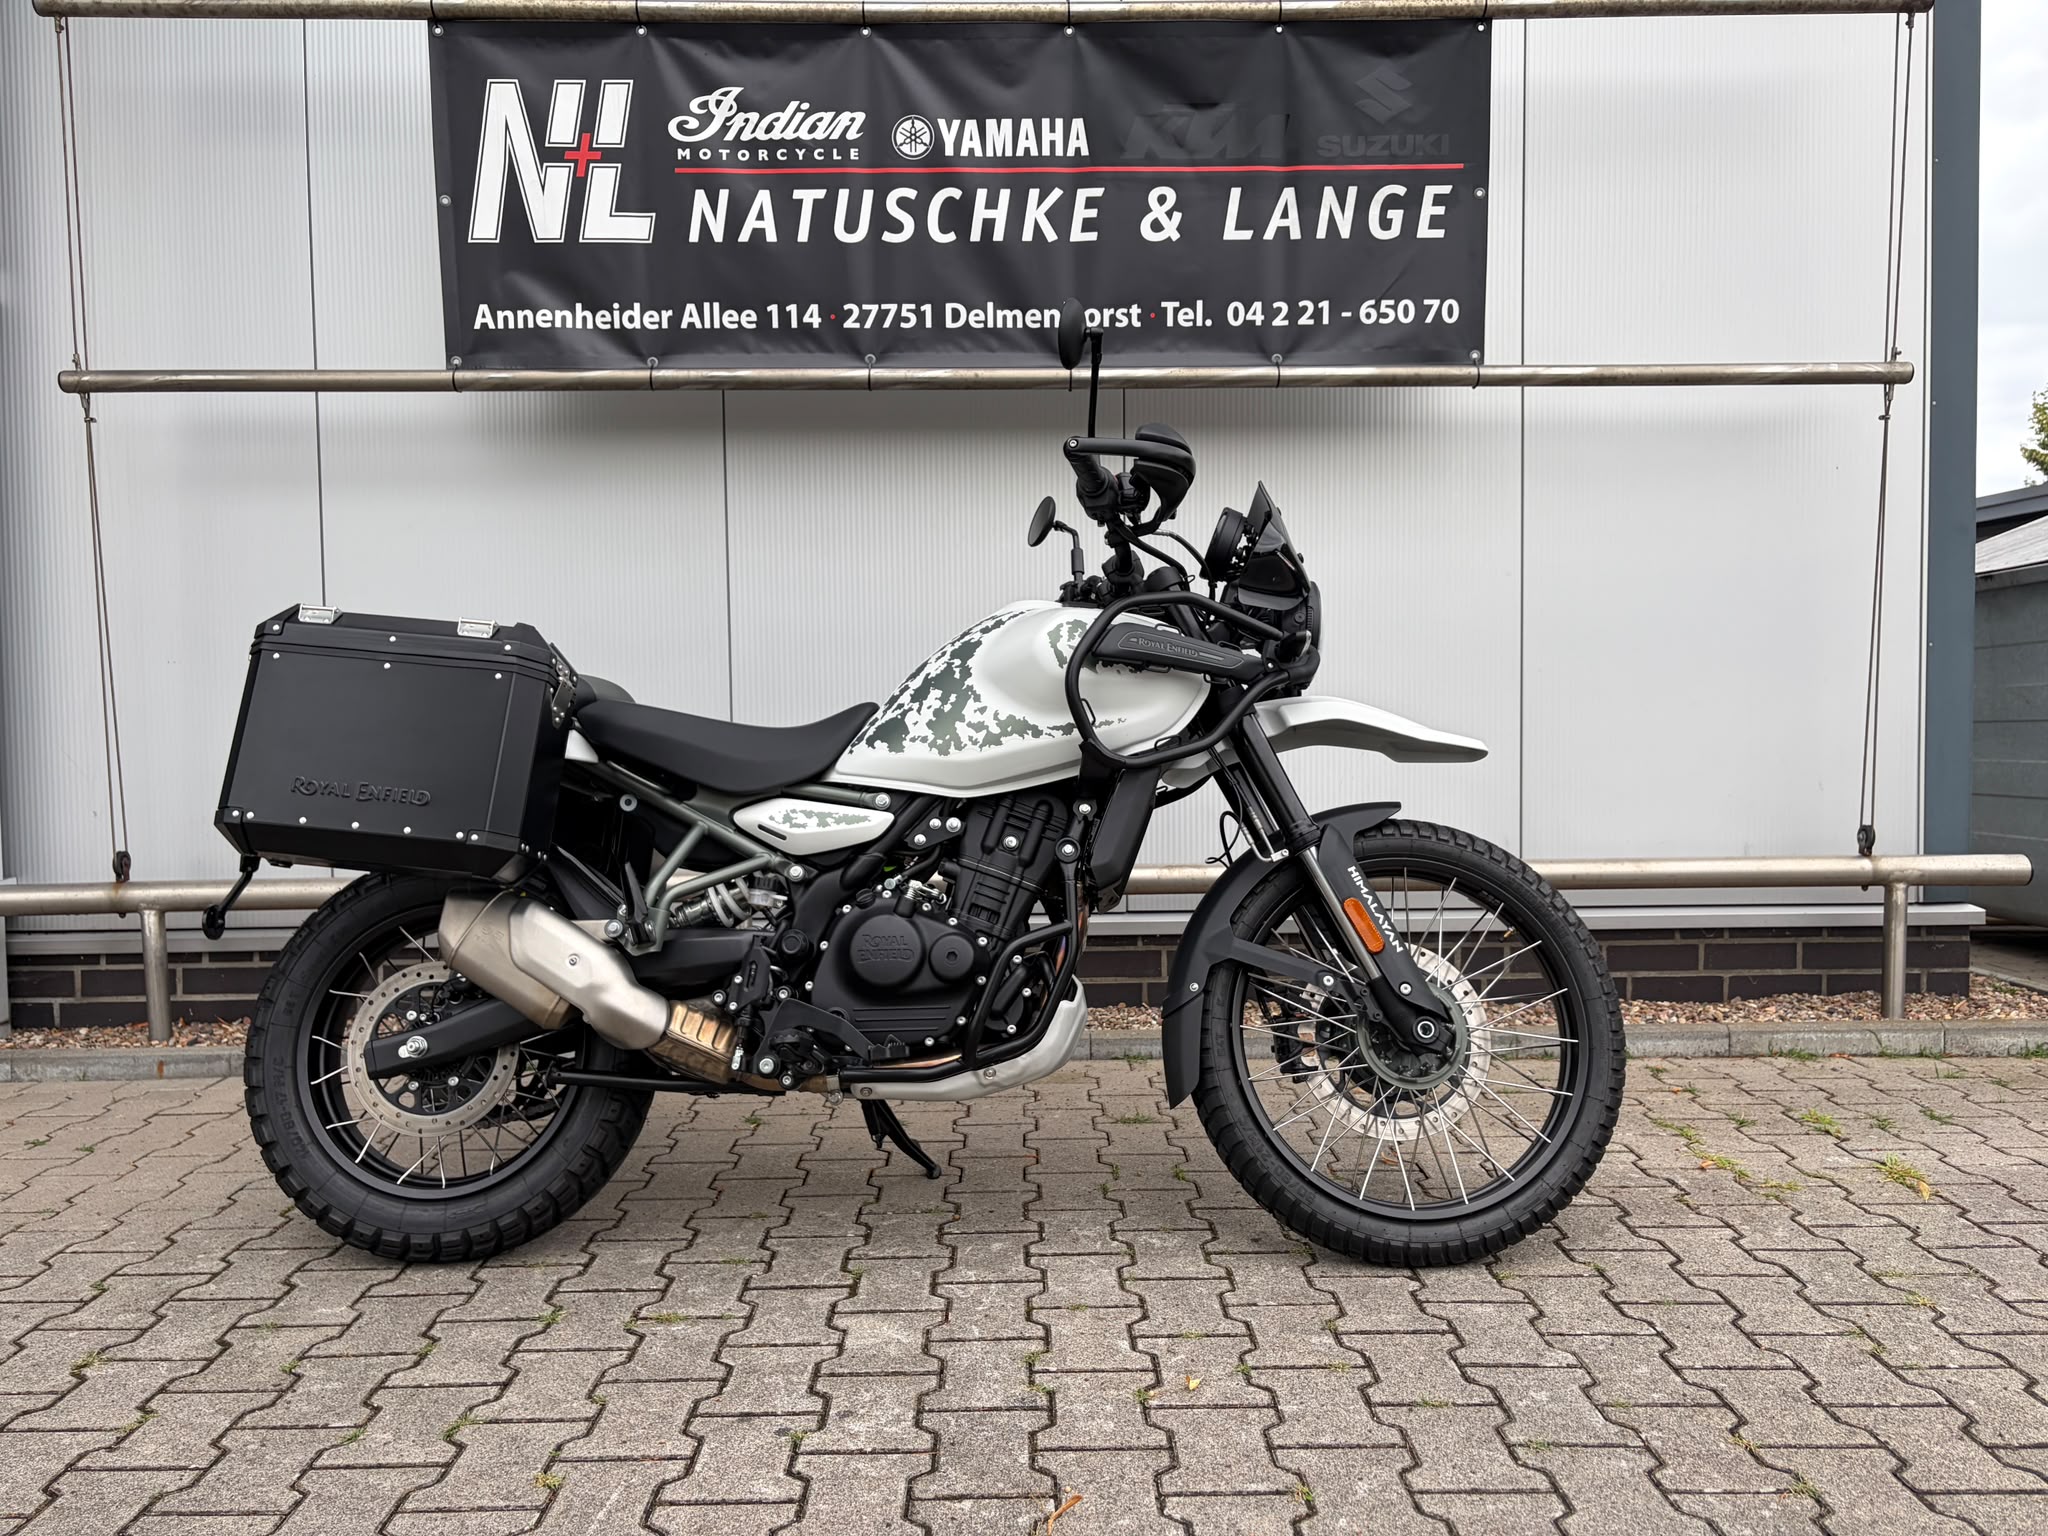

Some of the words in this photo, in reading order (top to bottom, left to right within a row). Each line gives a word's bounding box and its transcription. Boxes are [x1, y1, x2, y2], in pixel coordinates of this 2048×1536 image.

[667, 87, 867, 142] Indian
[938, 117, 1090, 158] YAMAHA
[1316, 133, 1450, 158] SUZUKI
[677, 147, 860, 162] MOTORCYCLE
[688, 186, 1105, 244] NATUSCHKE
[1140, 186, 1183, 243] &
[1222, 184, 1453, 241] LANGE
[474, 302, 673, 330] Annenheider
[681, 302, 757, 329] Allee
[766, 303, 822, 329] 114
[842, 302, 932, 329] 27751
[945, 301, 1142, 329] Delmenorst
[1160, 299, 1213, 328] Tel.
[1138, 637, 1165, 650] ROYAL
[1166, 643, 1198, 658] ENFIELD
[289, 775, 352, 799] ROYAL
[354, 781, 433, 807] ENFIELD
[1347, 865, 1404, 953] HIMALAYAN
[857, 948, 914, 962] ENFIELD
[862, 934, 909, 947] ROYAL
